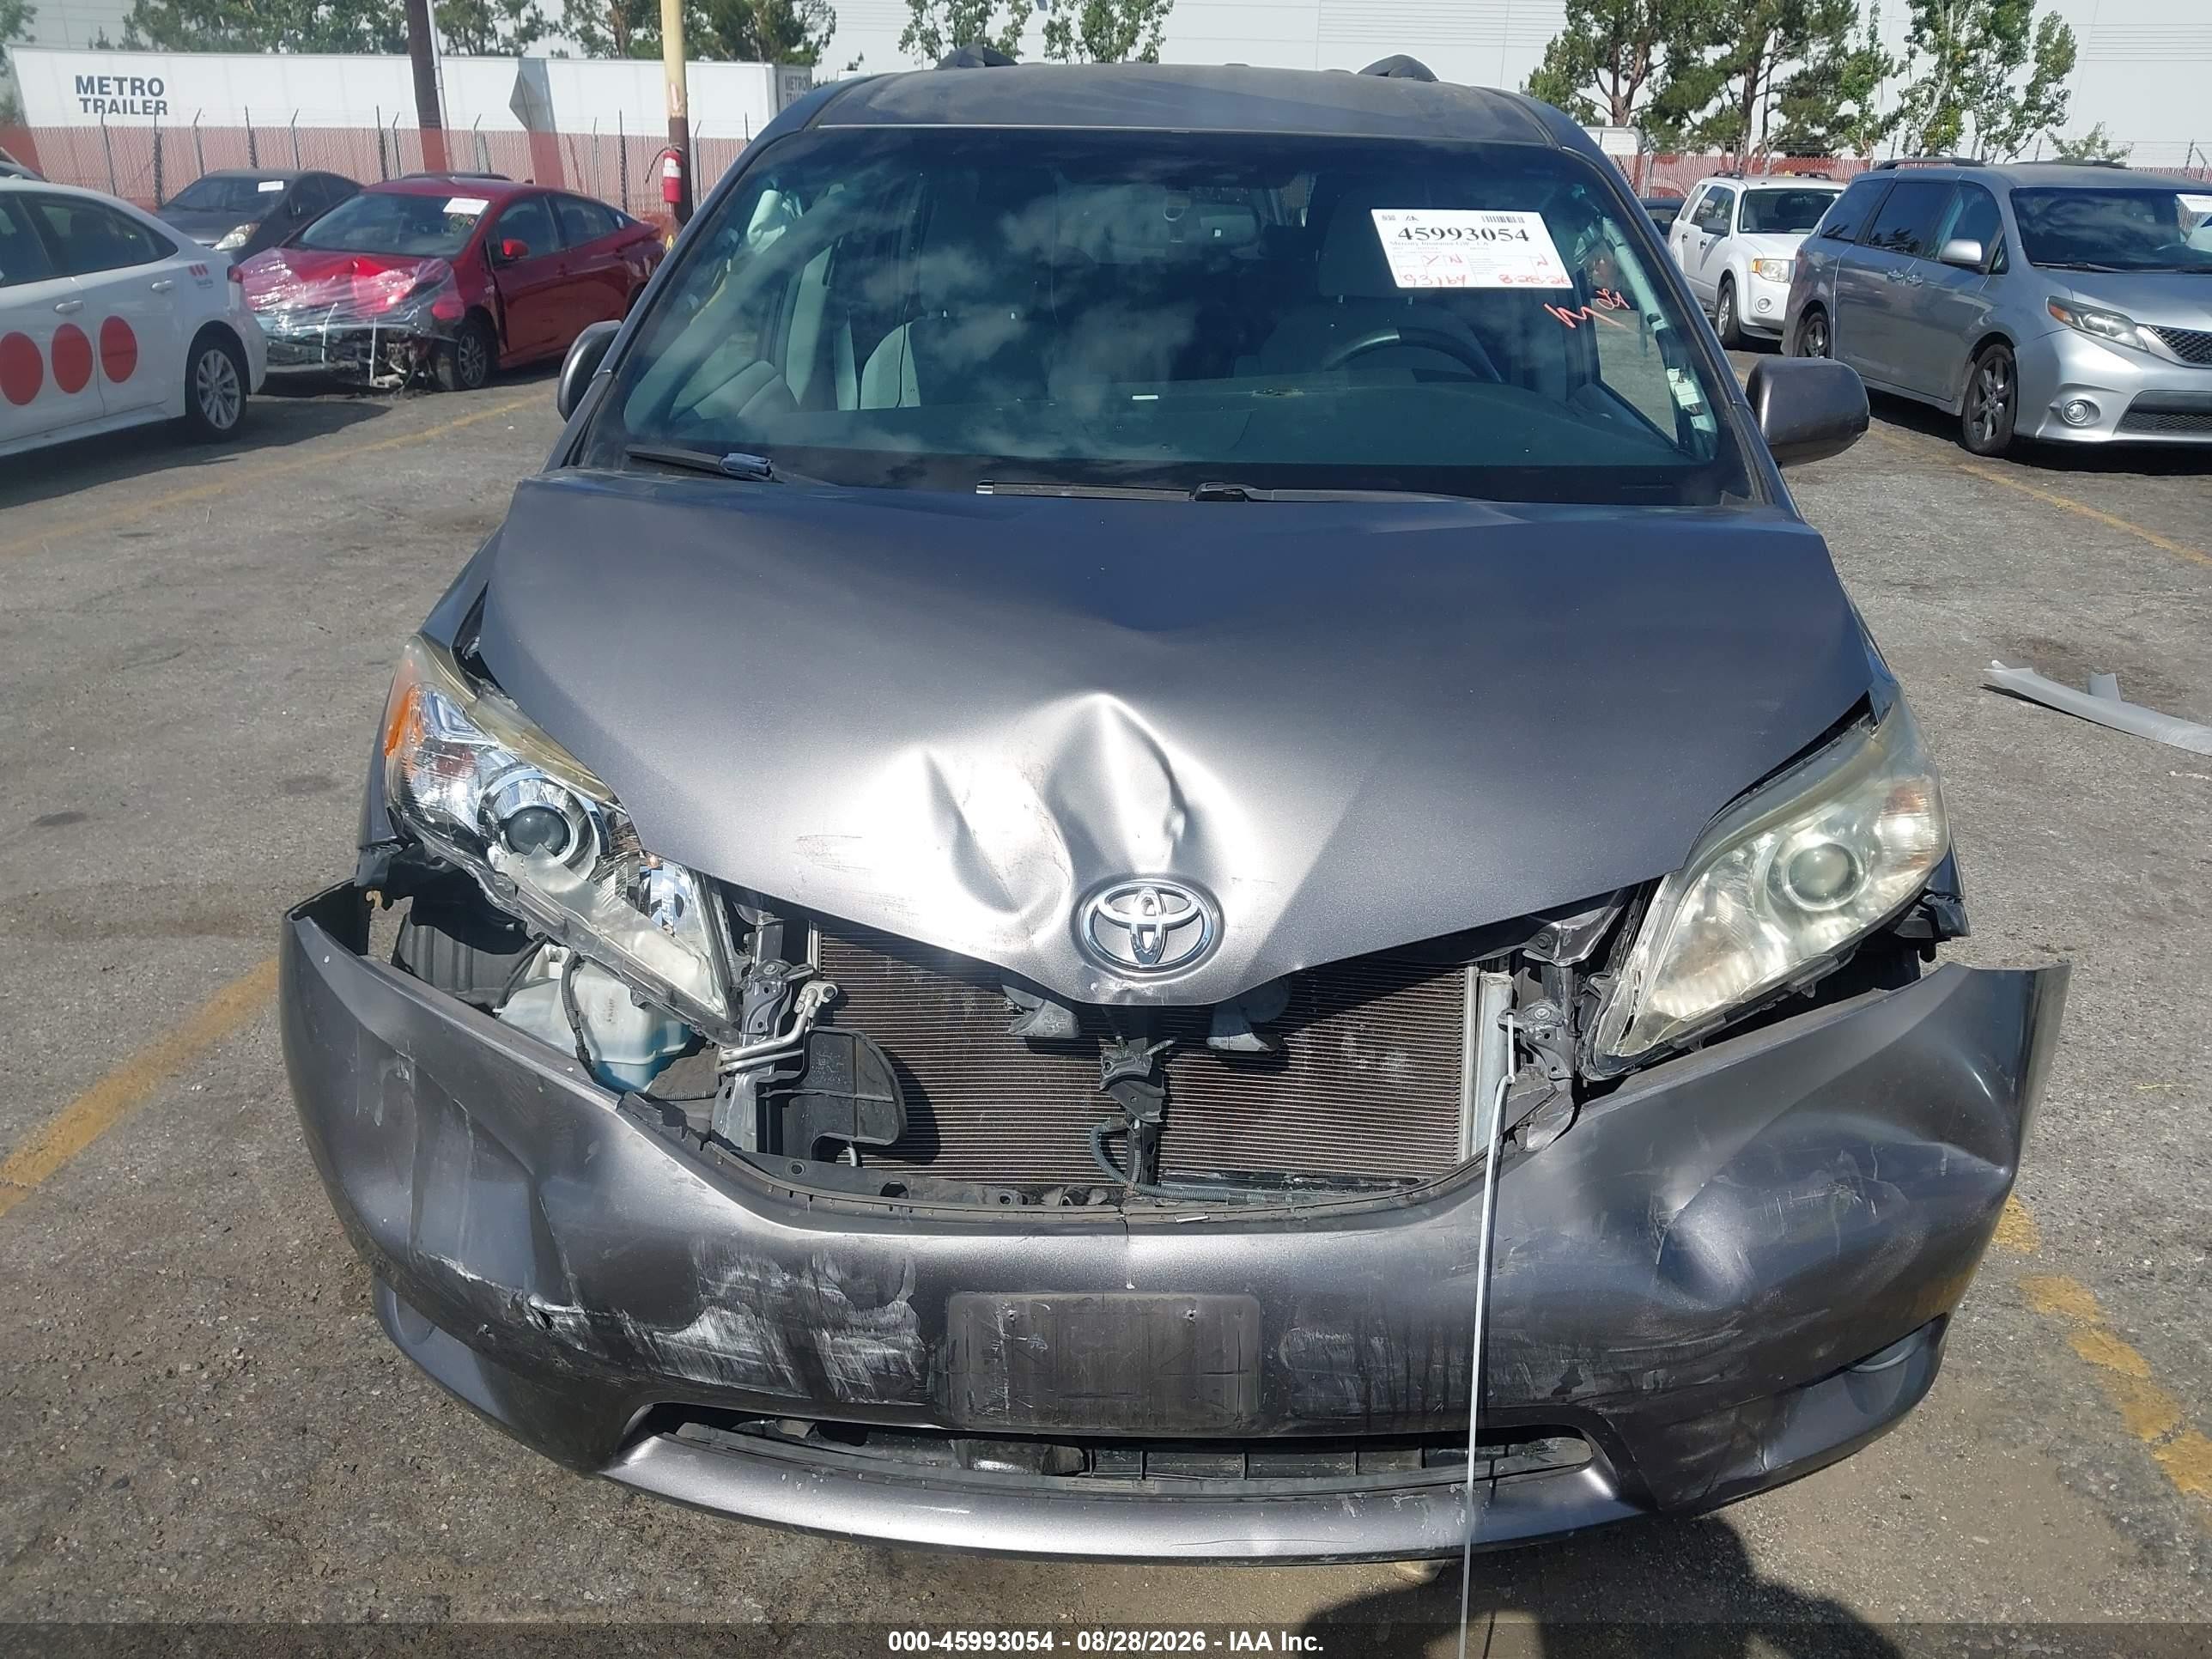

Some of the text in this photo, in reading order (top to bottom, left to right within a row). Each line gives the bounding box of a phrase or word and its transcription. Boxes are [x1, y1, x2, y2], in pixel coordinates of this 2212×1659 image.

[76, 75, 165, 96] METRO
[79, 98, 168, 115] TRAILER
[1398, 227, 1530, 241] 45993054
